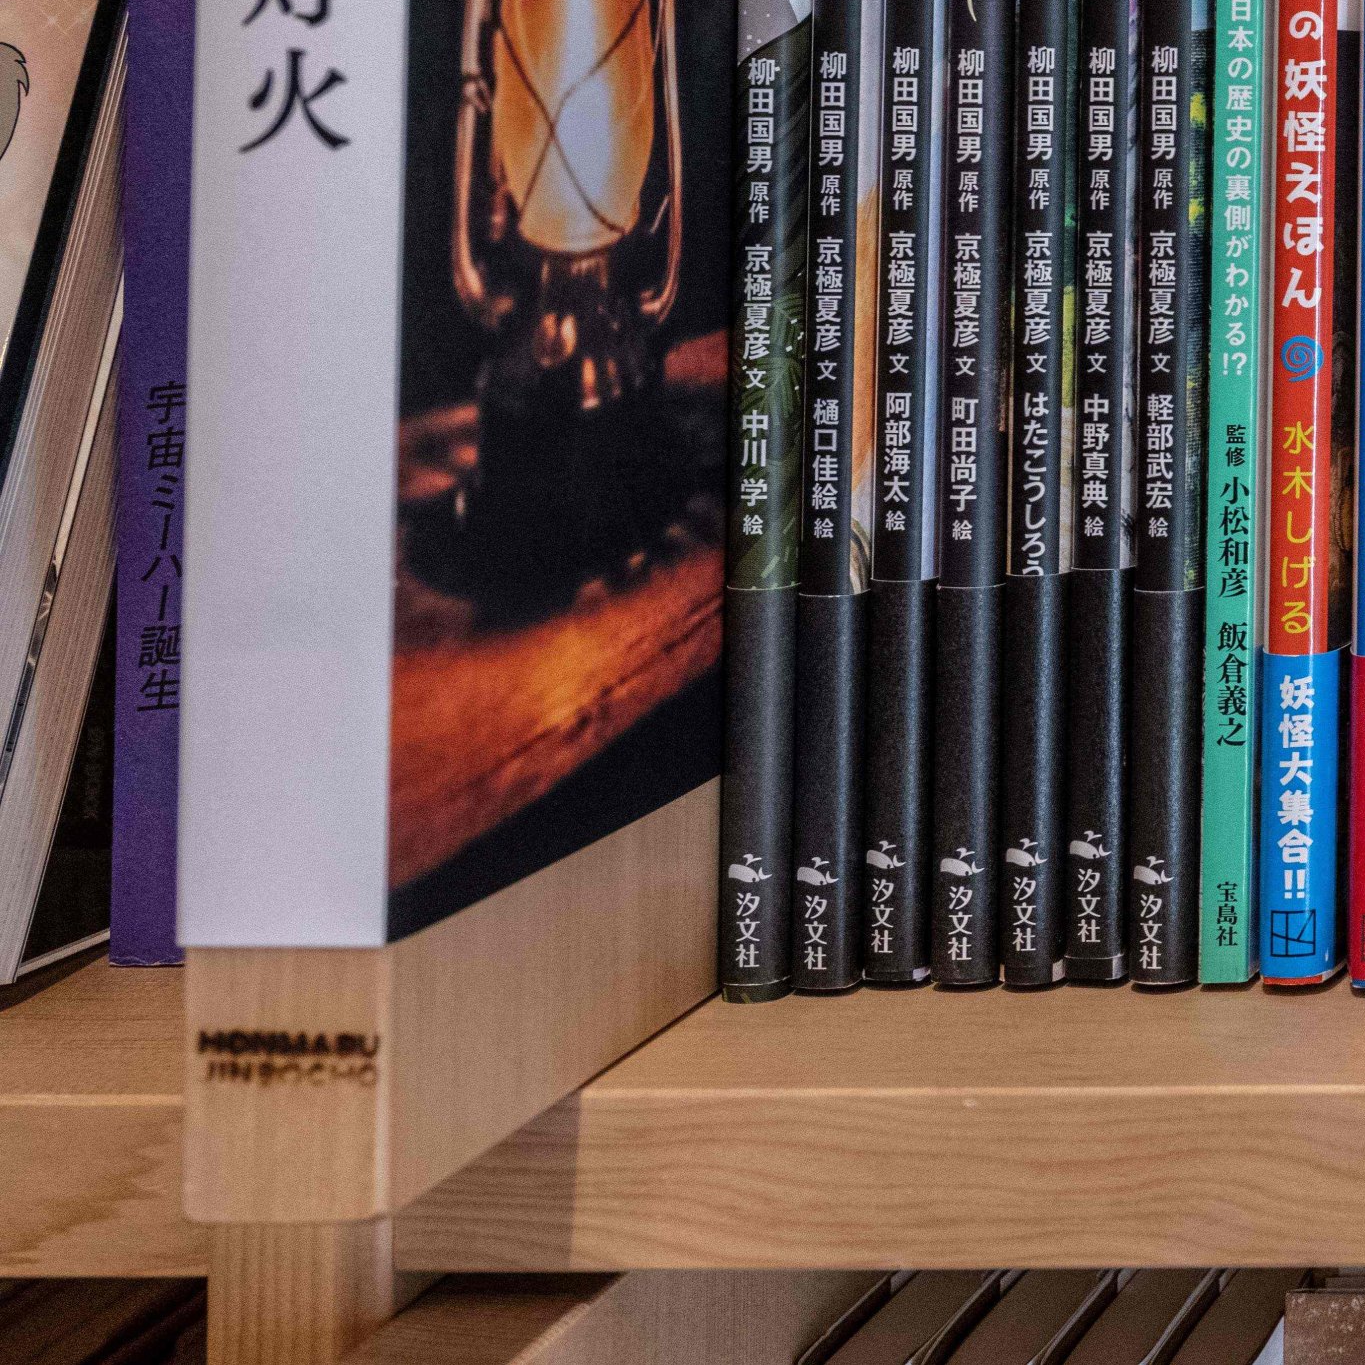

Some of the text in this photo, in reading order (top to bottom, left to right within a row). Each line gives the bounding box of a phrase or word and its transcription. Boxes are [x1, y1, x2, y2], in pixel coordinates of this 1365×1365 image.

[137, 380, 187, 712] 宇宙ミーハー誕生
[1216, 476, 1250, 598] 小松和彦
[1281, 421, 1316, 634] 水木しげる
[1215, 621, 1249, 747] 飯倉義之
[735, 891, 760, 968] 汐文社
[803, 895, 828, 971] 汐文社
[870, 878, 894, 955] 汐文社
[948, 885, 973, 961] 汐文社
[1012, 876, 1038, 952] 汐文社
[1077, 868, 1102, 944] 汐文社
[1138, 893, 1163, 970] 汐文社
[1216, 881, 1239, 947] 宝島社
